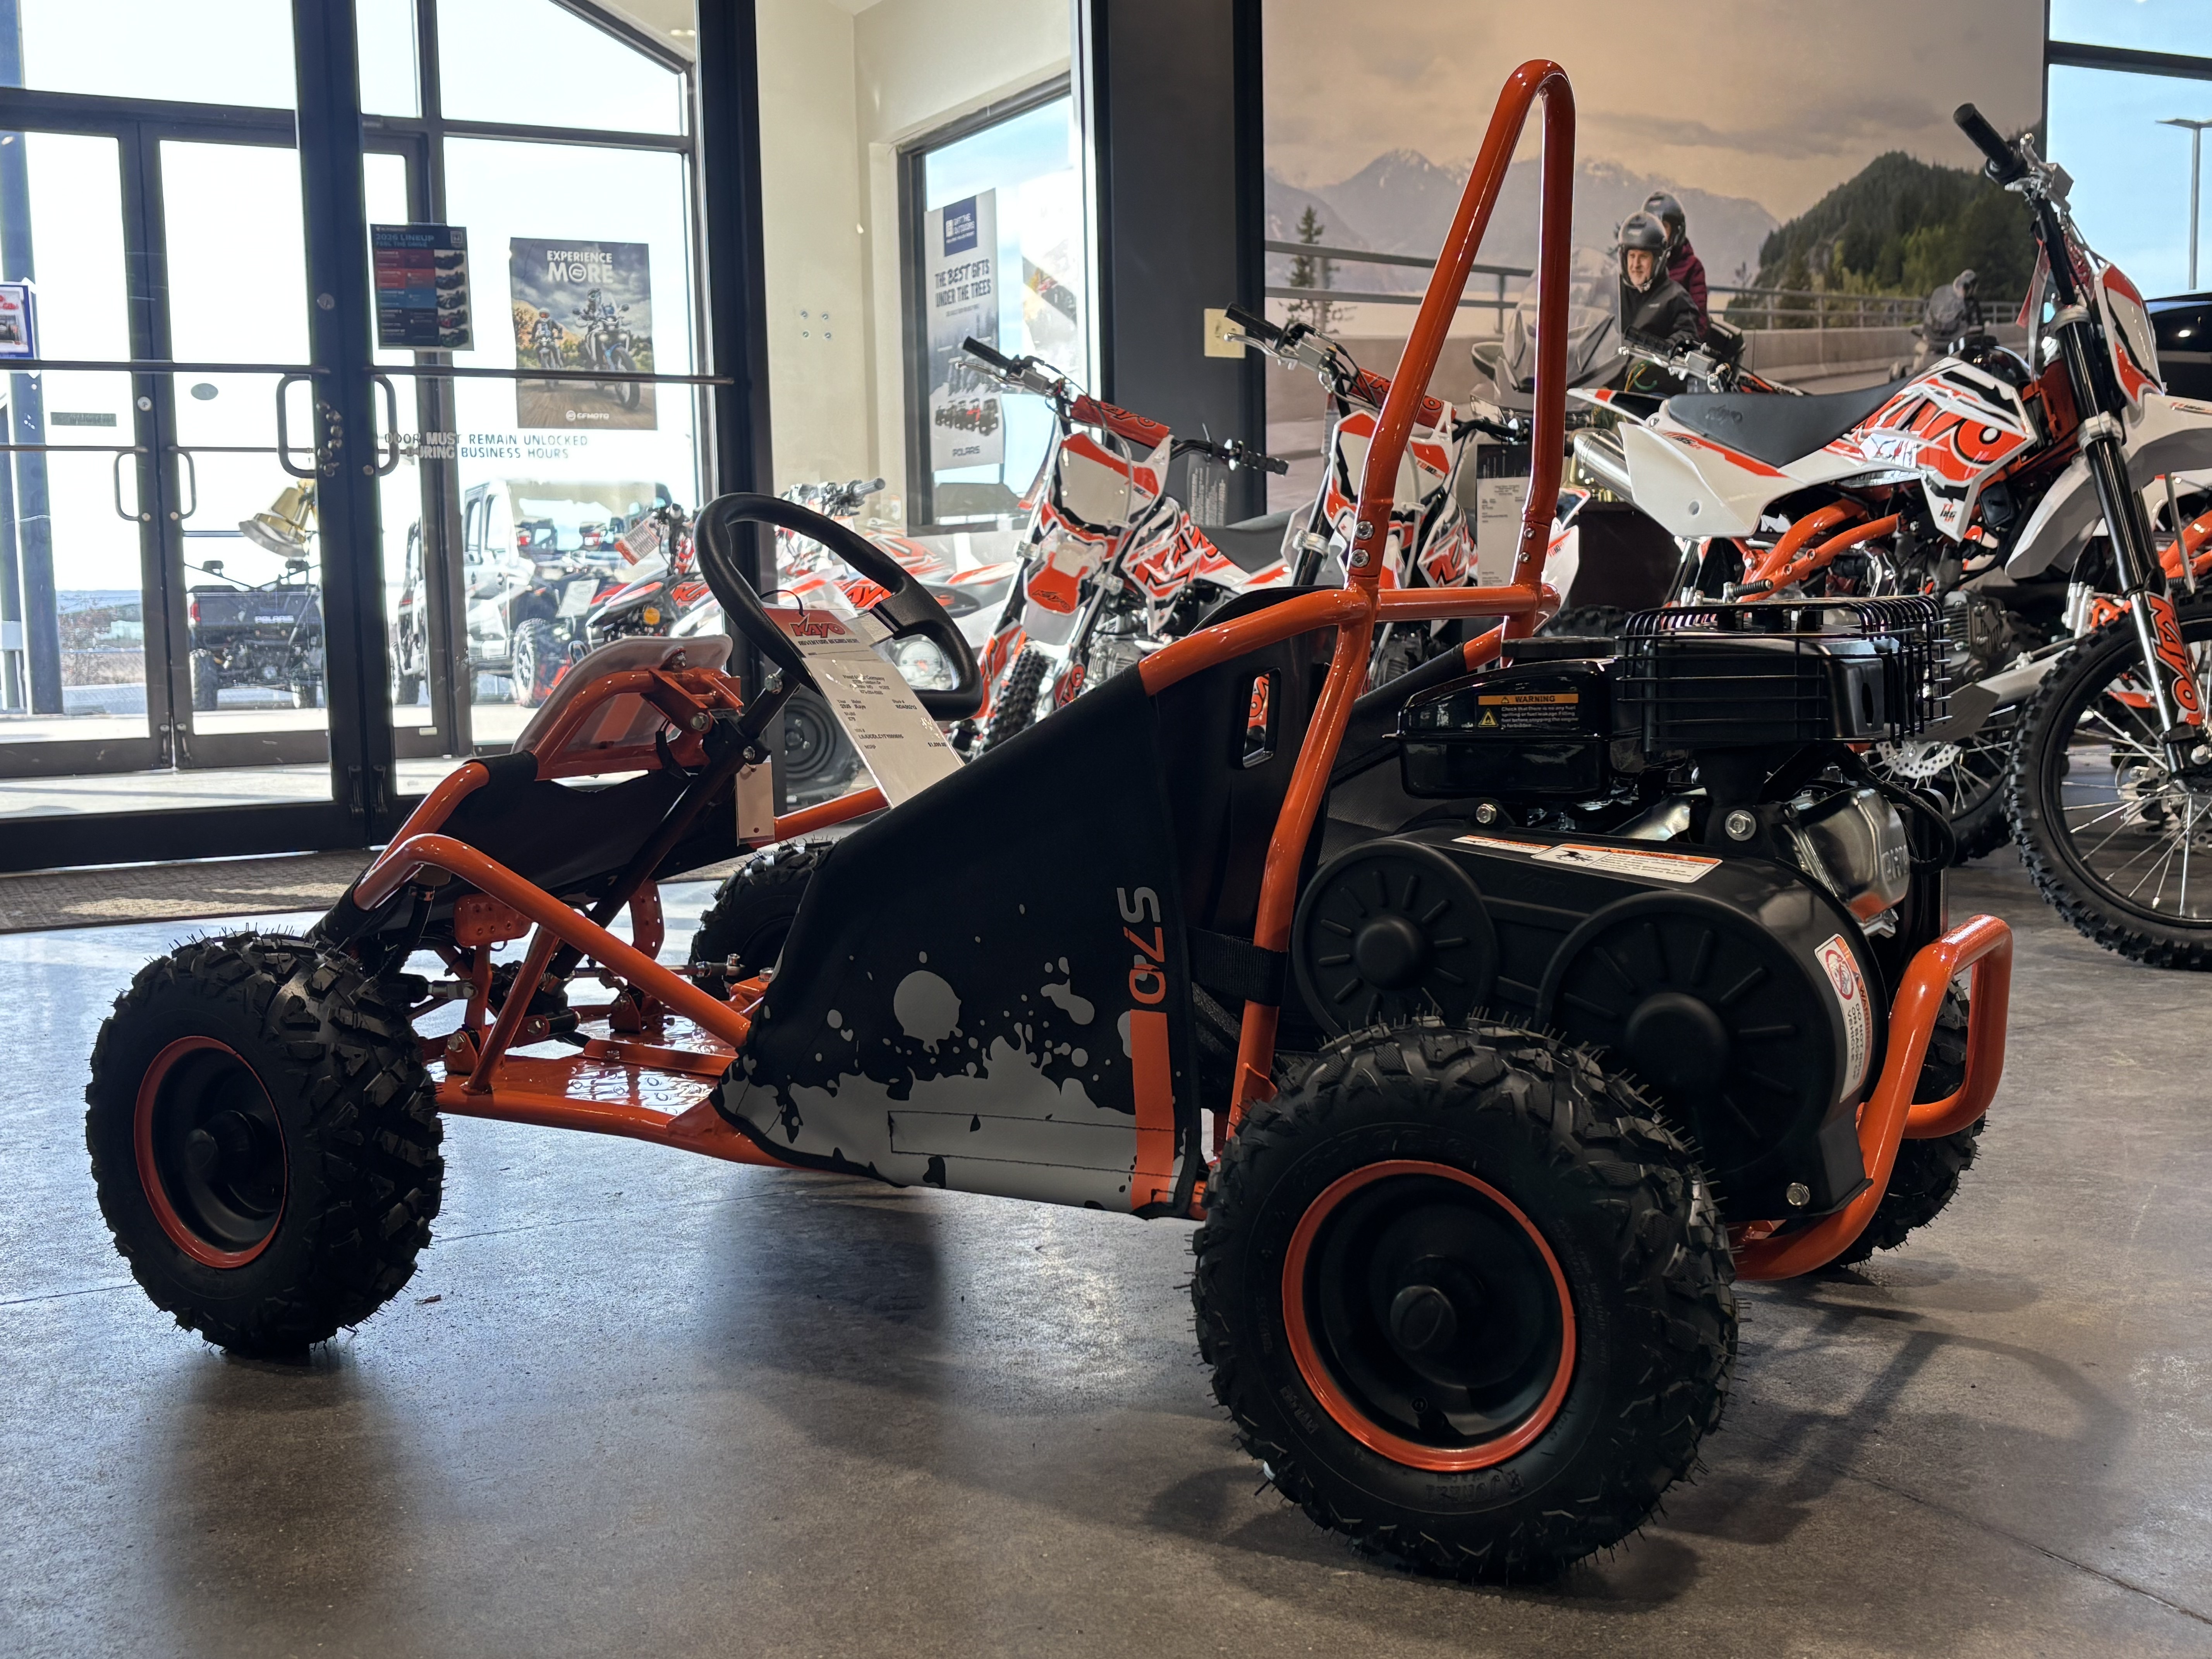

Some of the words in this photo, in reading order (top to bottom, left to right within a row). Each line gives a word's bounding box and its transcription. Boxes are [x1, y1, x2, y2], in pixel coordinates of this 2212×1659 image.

[547, 250, 613, 263] EXPERIENCE
[934, 271, 946, 289] THE
[947, 263, 971, 285] BEST
[971, 258, 990, 278] GIFTS
[935, 288, 956, 307] UNDER
[957, 284, 969, 302] THE
[970, 278, 991, 298] TREES
[384, 433, 421, 445] DOOR
[426, 432, 461, 445] MUST
[469, 434, 517, 445] REMAIN
[524, 435, 588, 446] UNLOCKED
[406, 445, 455, 459] DURING
[461, 447, 520, 459] BUSINESS
[527, 448, 568, 459] HOURS
[952, 445, 980, 457] POLARIS
[255, 615, 294, 624] POLARIS
[789, 613, 845, 638] KAYO
[2144, 591, 2200, 714] KAYO
[1116, 886, 1166, 1004] S70
[1851, 1006, 1858, 1024] ON
[1856, 1002, 1862, 1021] DO
[1860, 985, 1870, 1049] WARNING
[1847, 1009, 1855, 1063] VEHICLE
